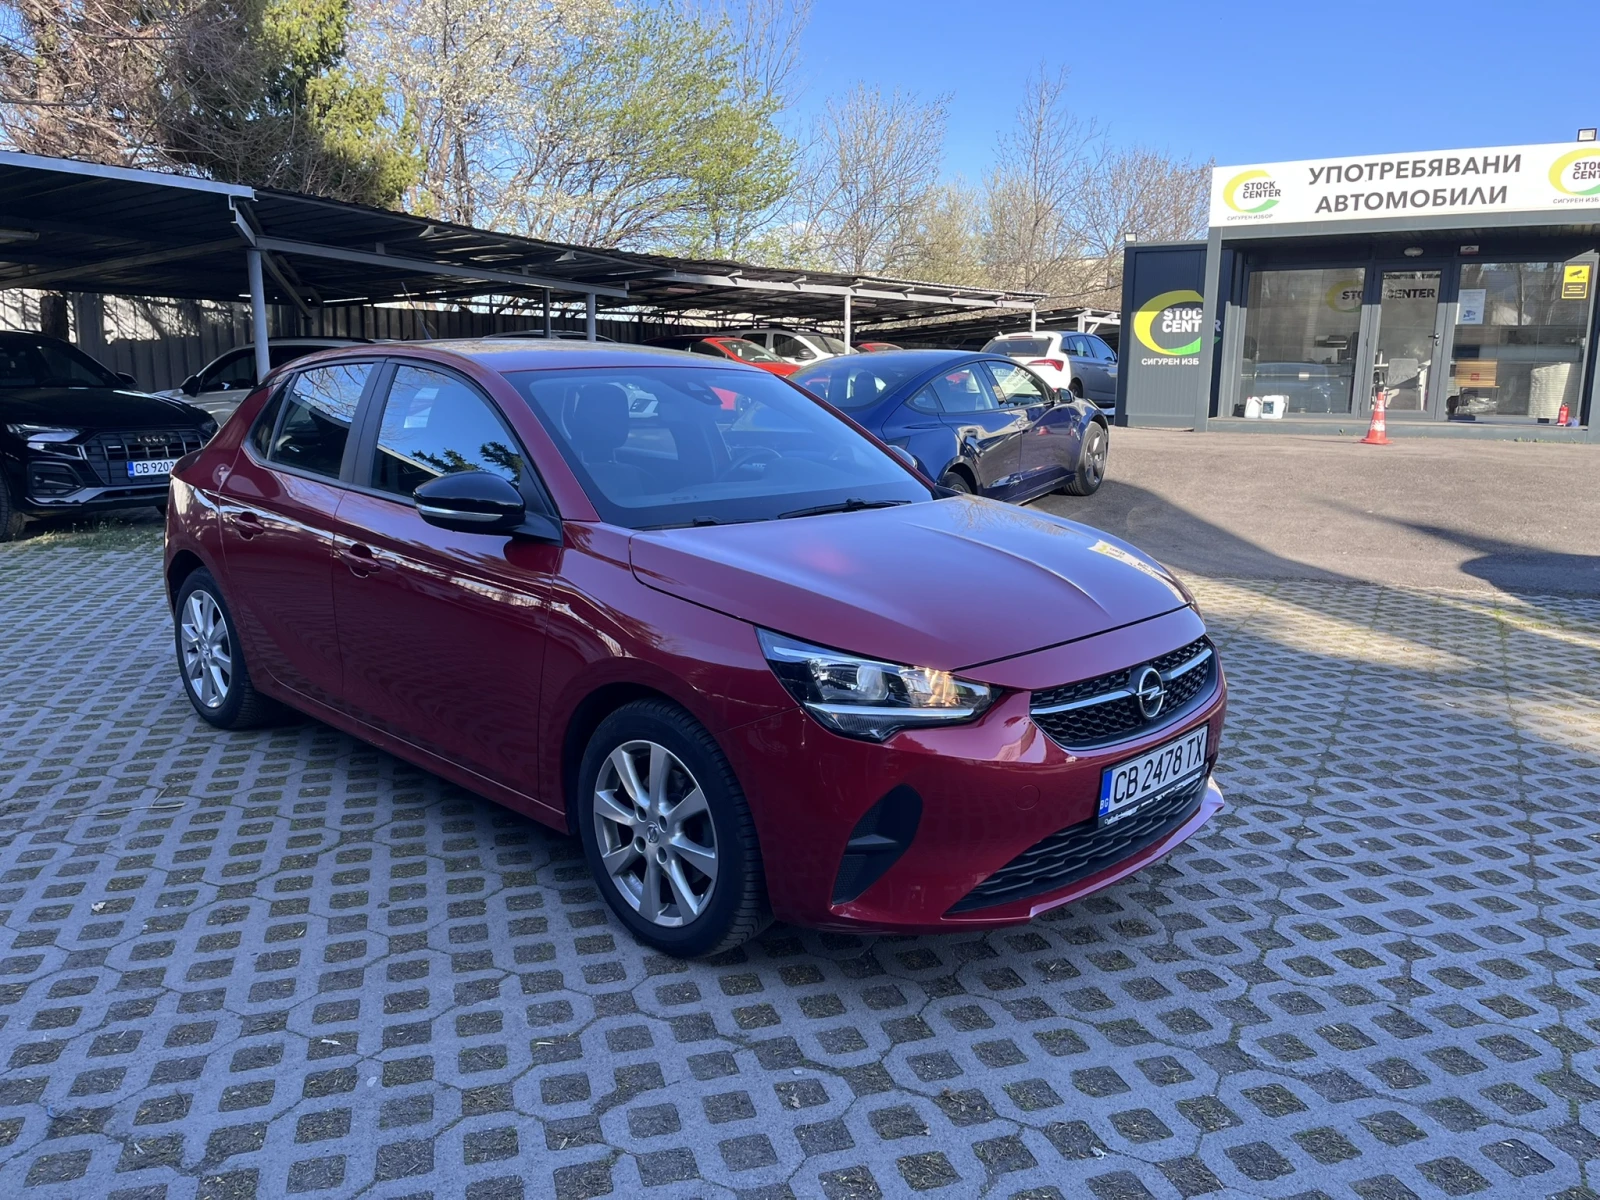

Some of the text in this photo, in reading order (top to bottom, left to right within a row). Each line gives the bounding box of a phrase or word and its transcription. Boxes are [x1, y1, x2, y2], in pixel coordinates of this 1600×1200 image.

[1309, 154, 1521, 185] УПОТРЕБЯВАНИ
[1244, 181, 1276, 190] STOCK
[1243, 189, 1281, 199] CENTER
[1314, 185, 1508, 214] АВТОМОБИЛИ
[1387, 288, 1436, 299] CENTER
[1163, 307, 1203, 320] STOC
[1141, 358, 1200, 366] СИГУРЕН ИЗБ
[135, 462, 150, 474] CB
[1113, 765, 1139, 804] CB
[1141, 745, 1183, 793] 2478
[1187, 732, 1205, 769] TX
[1100, 797, 1109, 810] BG
